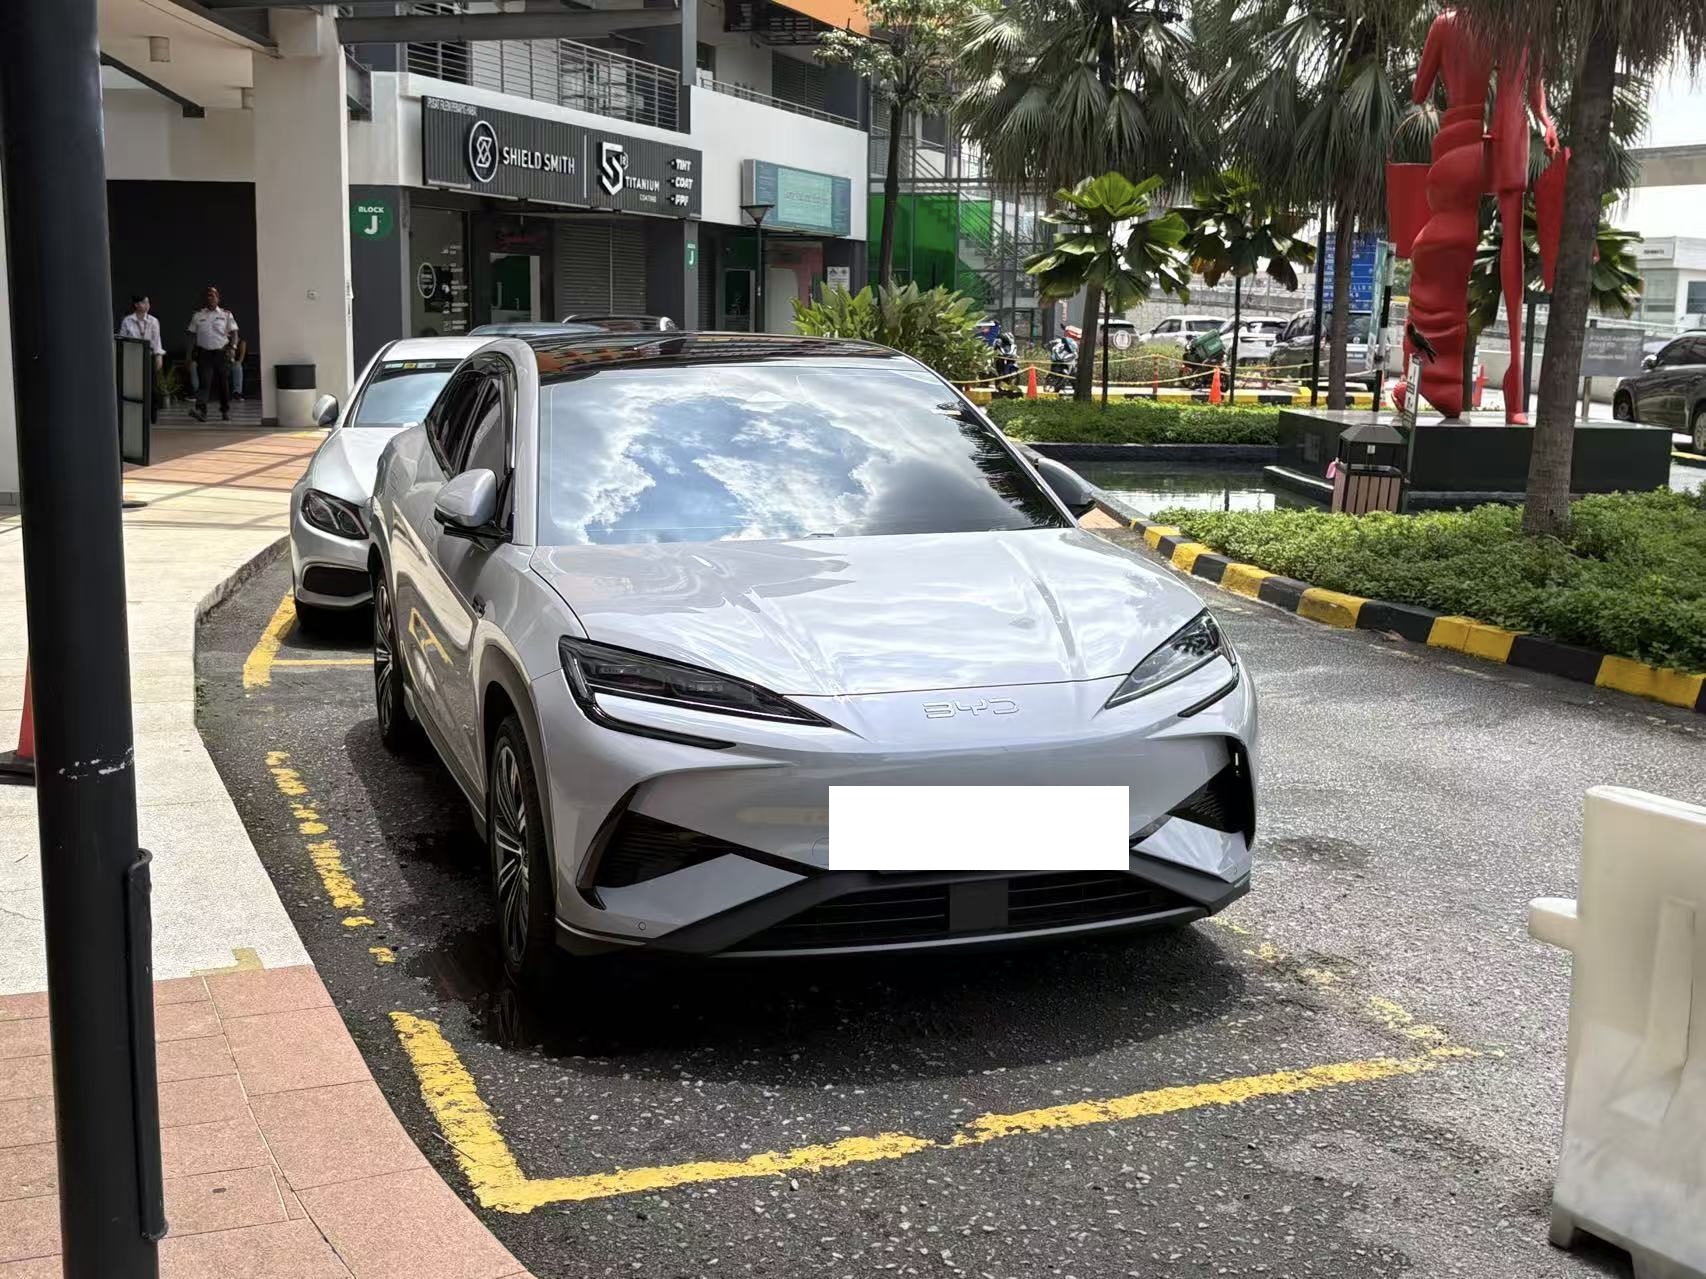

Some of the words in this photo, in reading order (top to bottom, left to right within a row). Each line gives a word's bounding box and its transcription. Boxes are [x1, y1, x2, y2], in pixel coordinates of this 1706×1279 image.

[503, 146, 542, 169] SHIELD
[544, 154, 575, 174] SMITH
[676, 158, 692, 171] TINT
[625, 176, 660, 192] TITANIUM
[675, 176, 693, 190] COAT
[364, 215, 378, 235] J
[688, 250, 694, 265] J
[922, 695, 1020, 719] BYD
